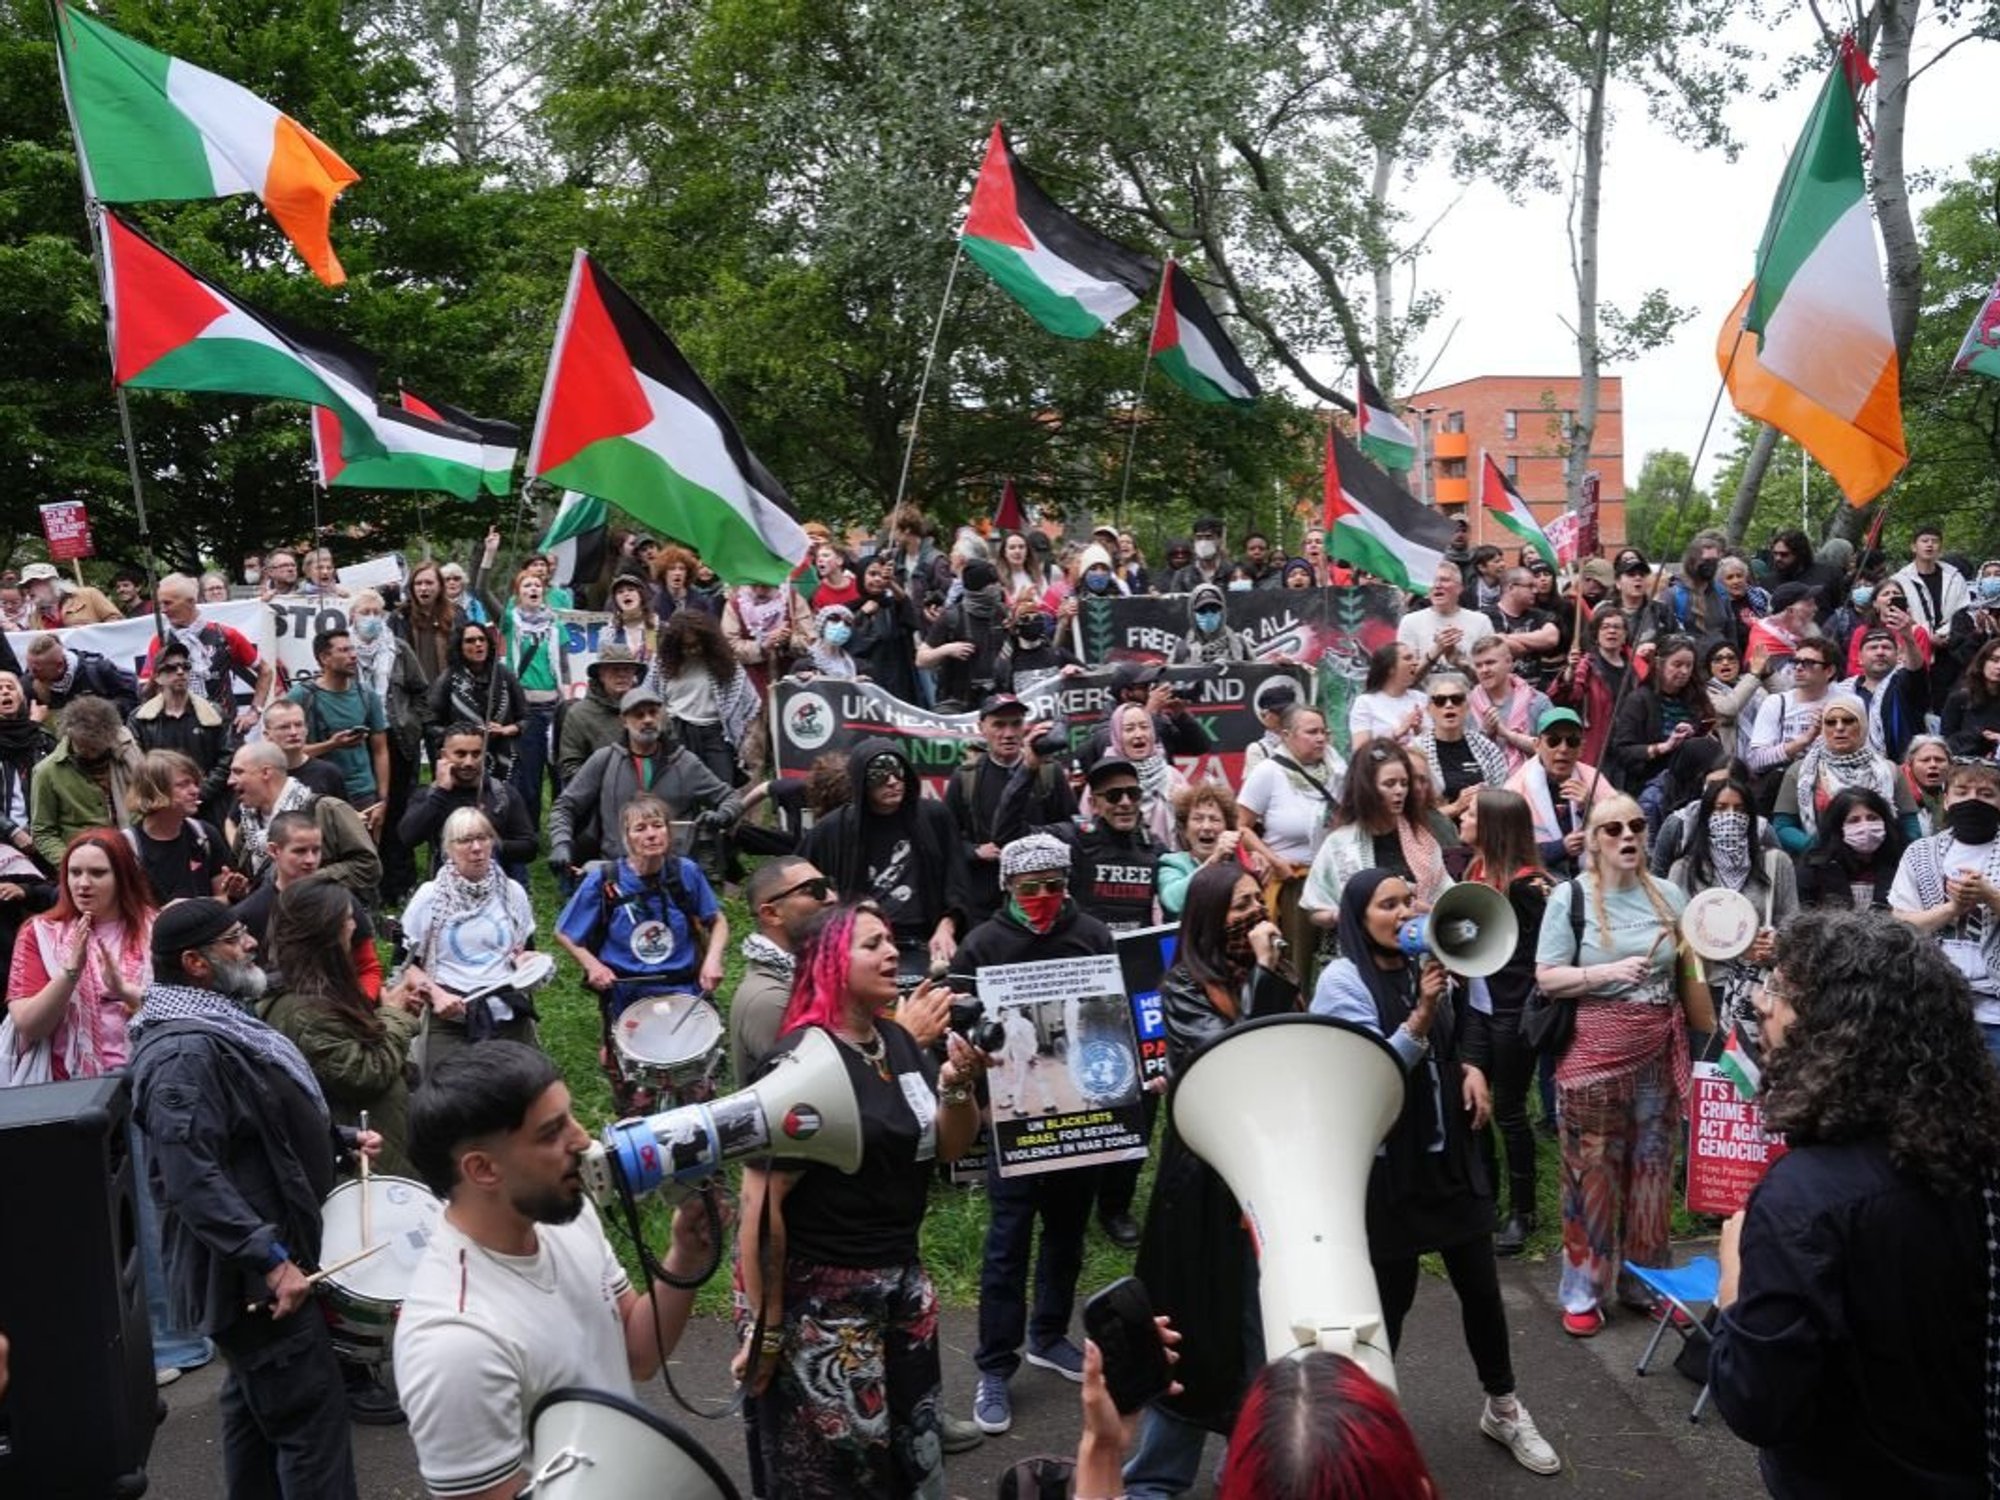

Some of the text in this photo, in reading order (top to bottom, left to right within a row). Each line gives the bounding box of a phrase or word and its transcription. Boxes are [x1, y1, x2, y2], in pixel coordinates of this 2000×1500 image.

[1260, 609, 1300, 640] ALL
[1127, 626, 1182, 654] FREE
[841, 695, 880, 722] UK
[1095, 864, 1152, 884] FREE
[1700, 1081, 1729, 1100] IT'S
[1027, 1111, 1114, 1132] UN BLACKLISTS
[1700, 1100, 1747, 1122] CRIME
[1016, 1122, 1126, 1147] ISRAEL FOR SEXUAL
[1698, 1119, 1727, 1139] ACT
[1004, 1133, 1141, 1162] VIOLENCE IN WAR ZONES
[1698, 1138, 1769, 1163] GENOCIDE
